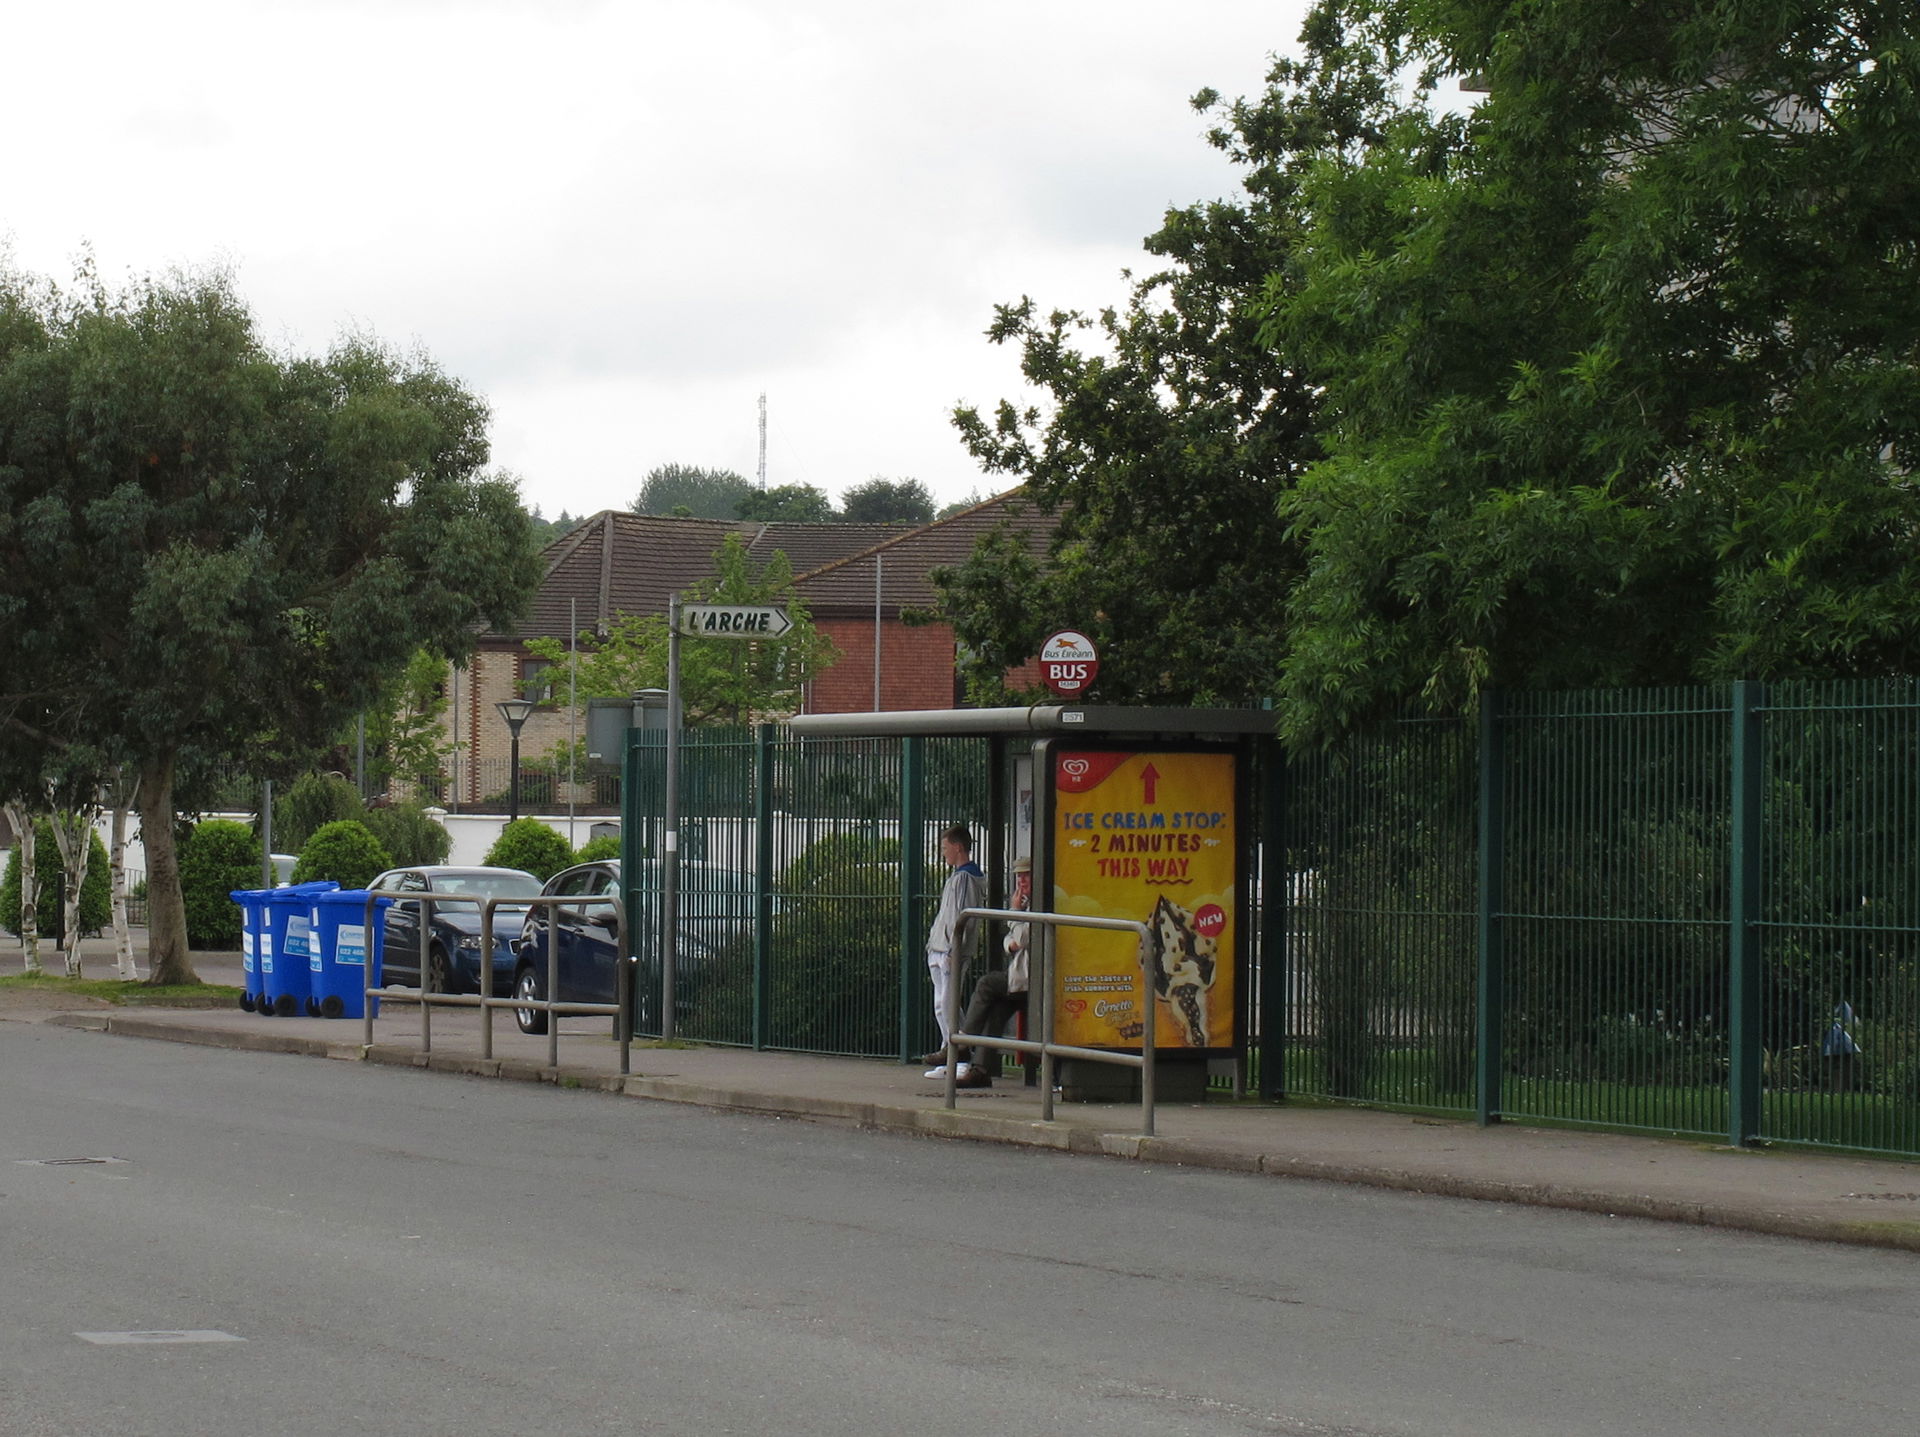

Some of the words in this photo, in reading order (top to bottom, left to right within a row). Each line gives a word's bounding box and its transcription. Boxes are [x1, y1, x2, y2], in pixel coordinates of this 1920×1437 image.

[689, 611, 770, 631] L'ARCHE
[1044, 650, 1060, 658] Bus
[1050, 664, 1088, 679] BUS
[1064, 812, 1093, 829] ICE
[1102, 812, 1165, 829] CREAM
[1091, 835, 1100, 853] 2
[1109, 834, 1202, 853] MINUTES
[1098, 858, 1140, 877] THIS
[1147, 858, 1189, 876] WAY
[1198, 912, 1223, 928] NEW
[1095, 1000, 1133, 1017] Cornetto
